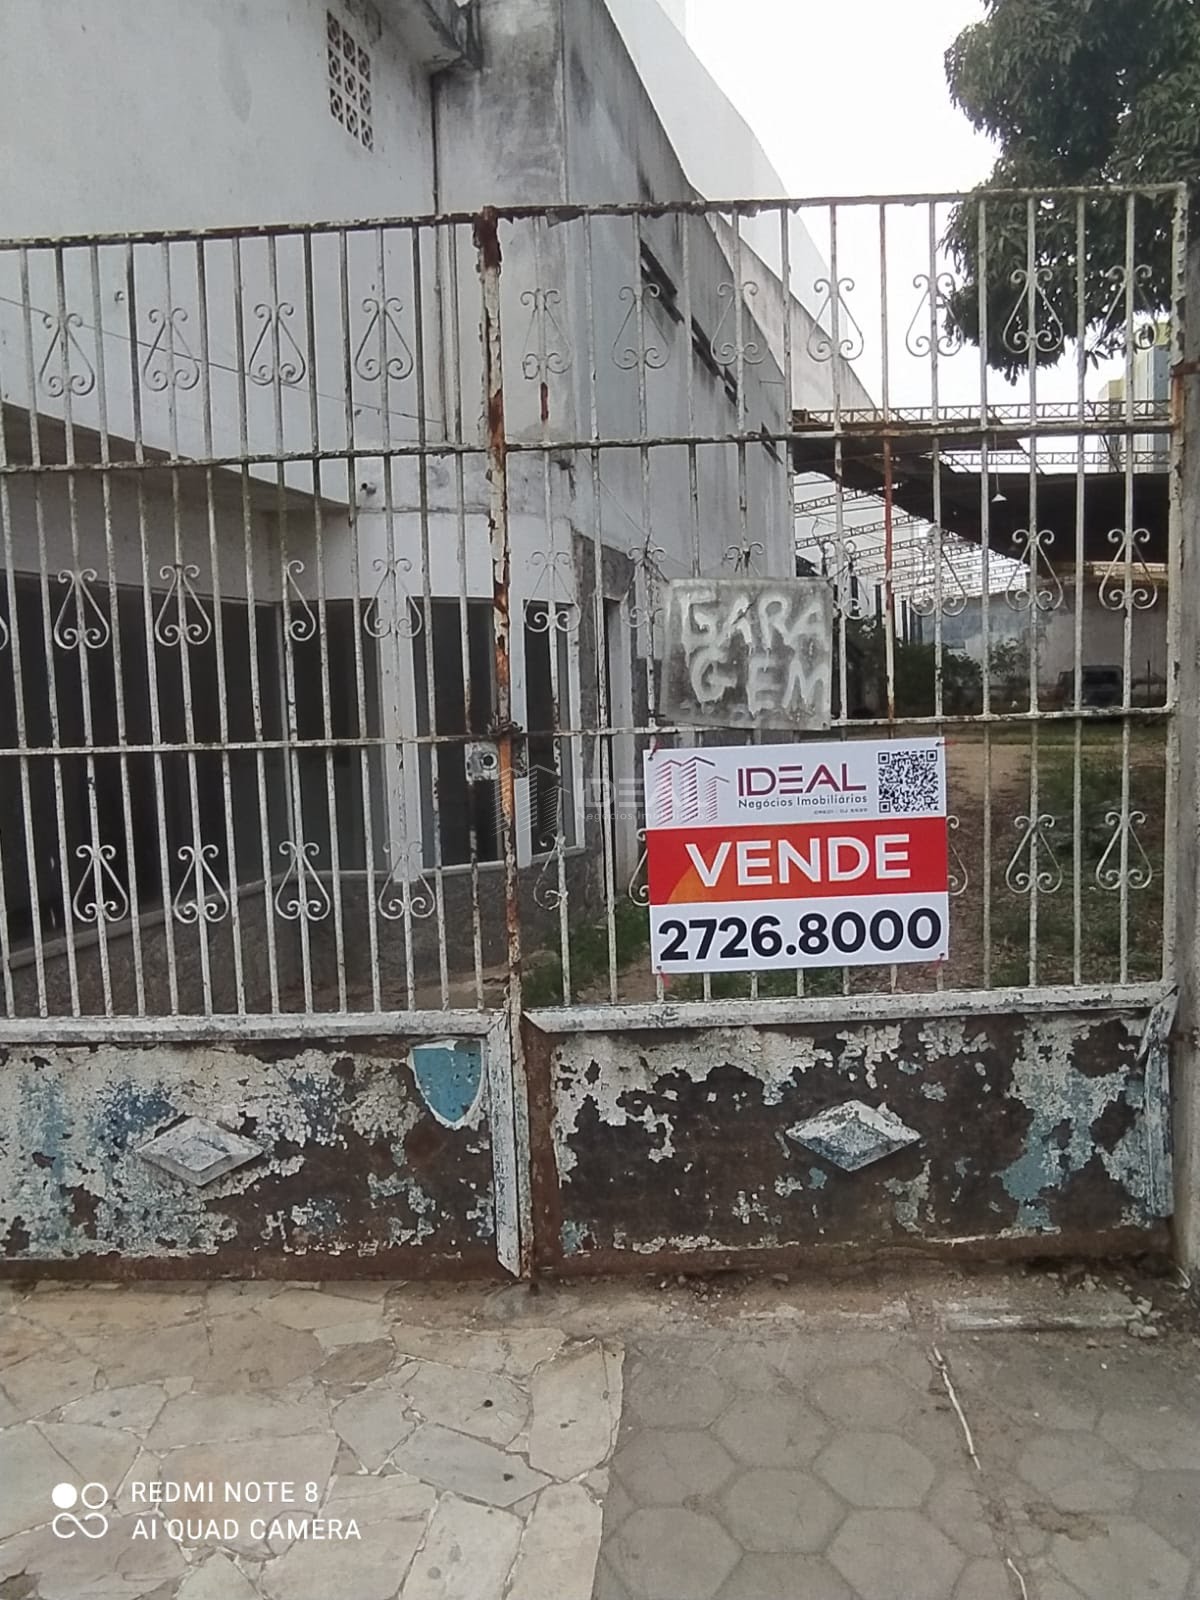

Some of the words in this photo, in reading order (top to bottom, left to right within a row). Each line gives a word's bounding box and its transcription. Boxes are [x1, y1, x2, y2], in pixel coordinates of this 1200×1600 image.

[691, 650, 830, 716] GEM
[737, 763, 867, 797] IDEAL
[738, 798, 793, 811] Negócios
[797, 793, 867, 806] Imobiliários
[685, 833, 911, 888] VENDE
[657, 908, 941, 962] 2726.8000
